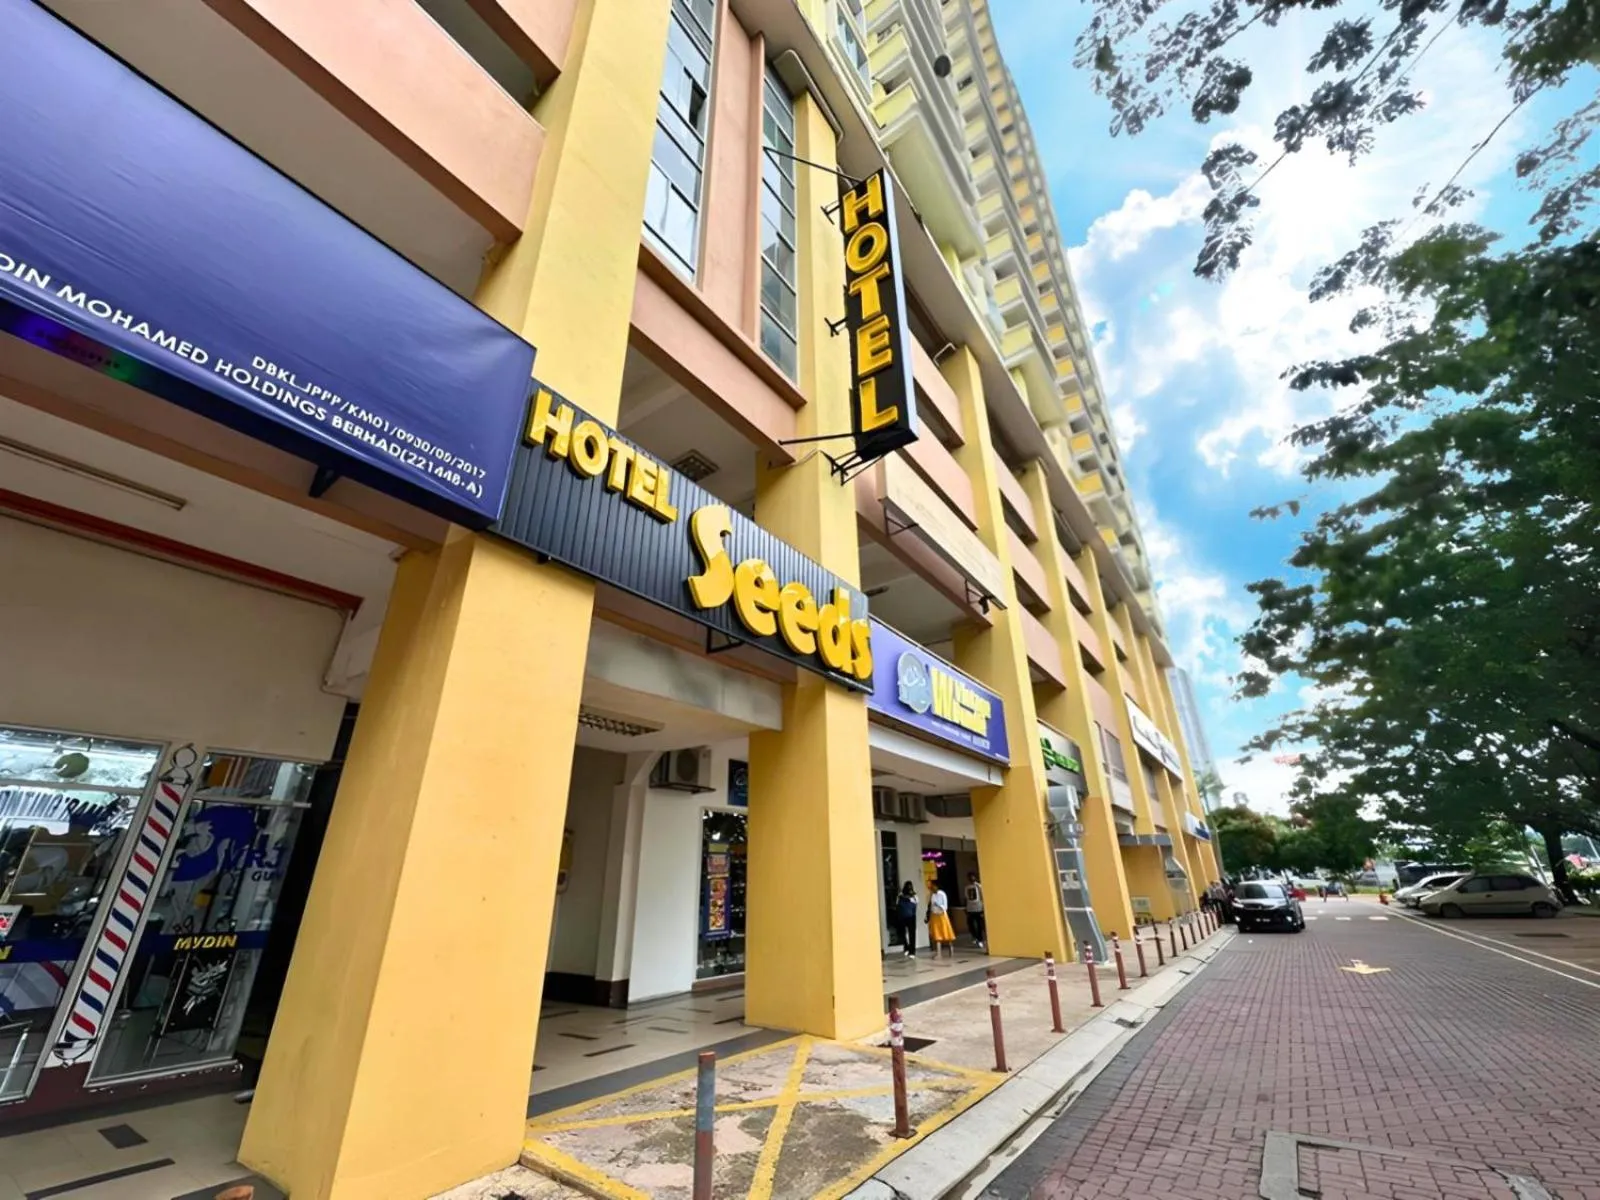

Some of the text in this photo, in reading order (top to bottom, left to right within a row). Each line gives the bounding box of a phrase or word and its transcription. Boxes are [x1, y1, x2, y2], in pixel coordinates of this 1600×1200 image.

[56, 285, 209, 365] MOHAMED
[214, 358, 327, 421] HOLDINGS
[842, 173, 898, 432] HOTEL
[525, 387, 679, 523] HOTEL
[687, 504, 873, 680] Seeds
[173, 934, 238, 951] MYDIN
